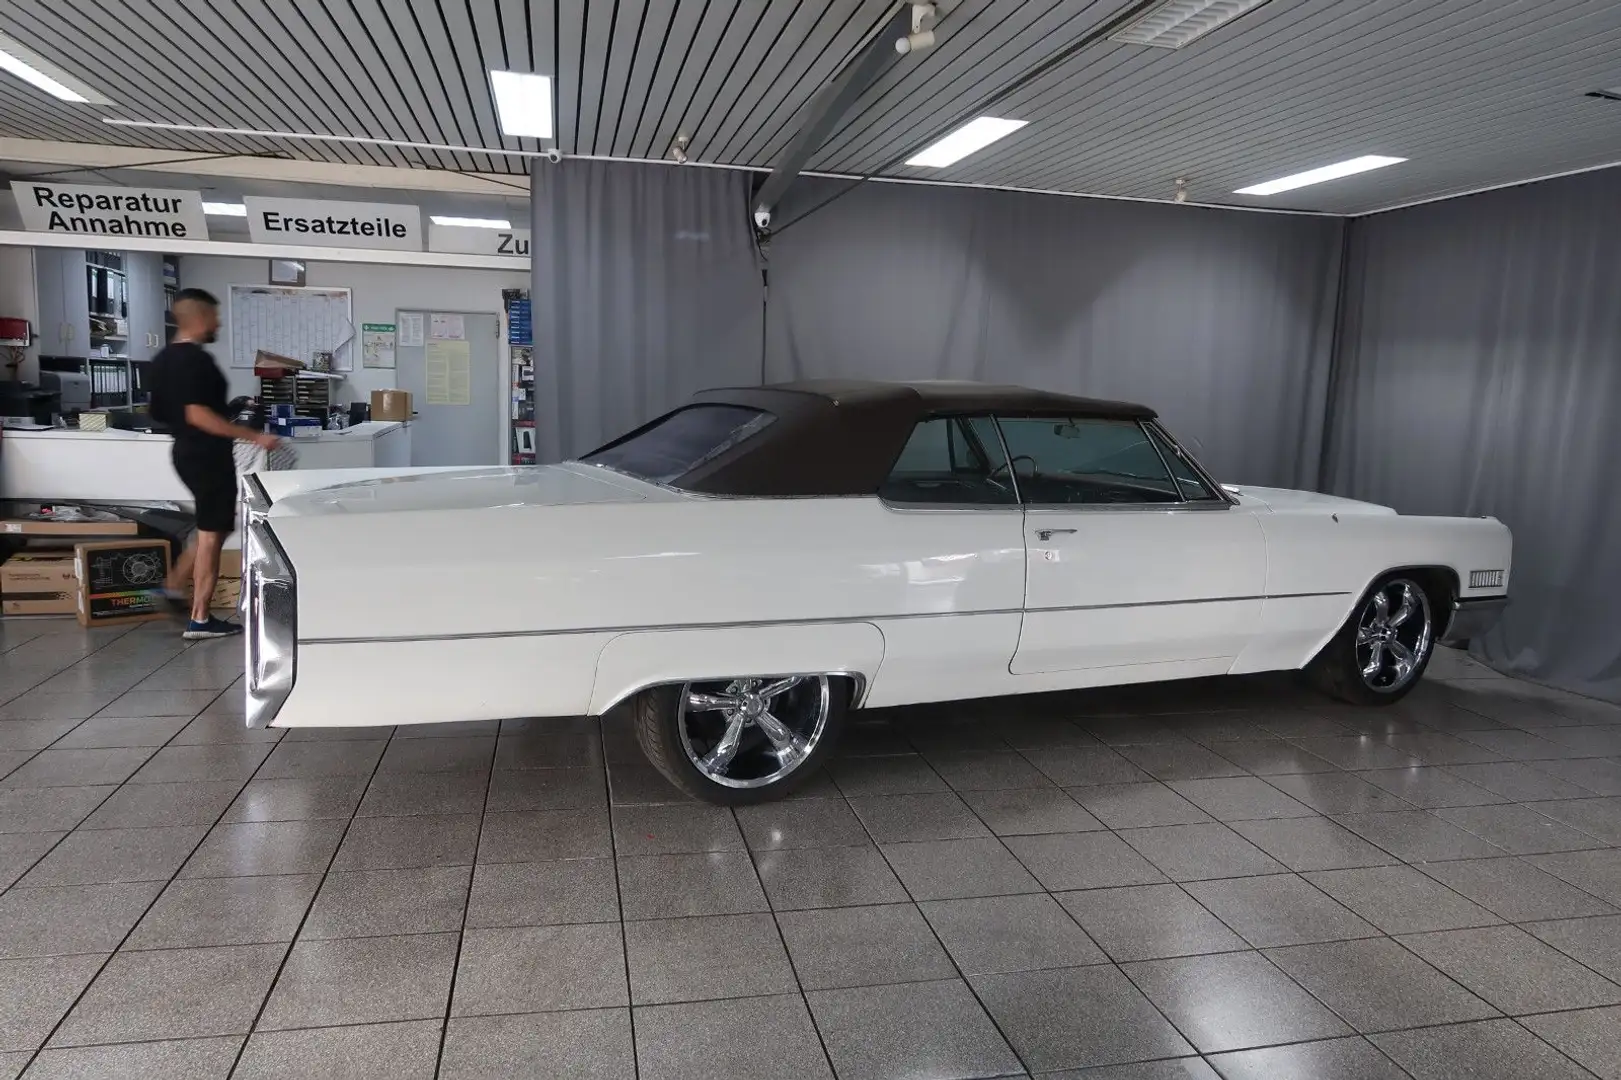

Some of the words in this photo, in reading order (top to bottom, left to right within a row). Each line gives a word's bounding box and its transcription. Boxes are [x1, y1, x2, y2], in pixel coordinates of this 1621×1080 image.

[32, 186, 182, 213] Reparatur
[48, 211, 187, 237] Annahme
[262, 211, 407, 239] Ersatzteile
[497, 233, 529, 255] Zu
